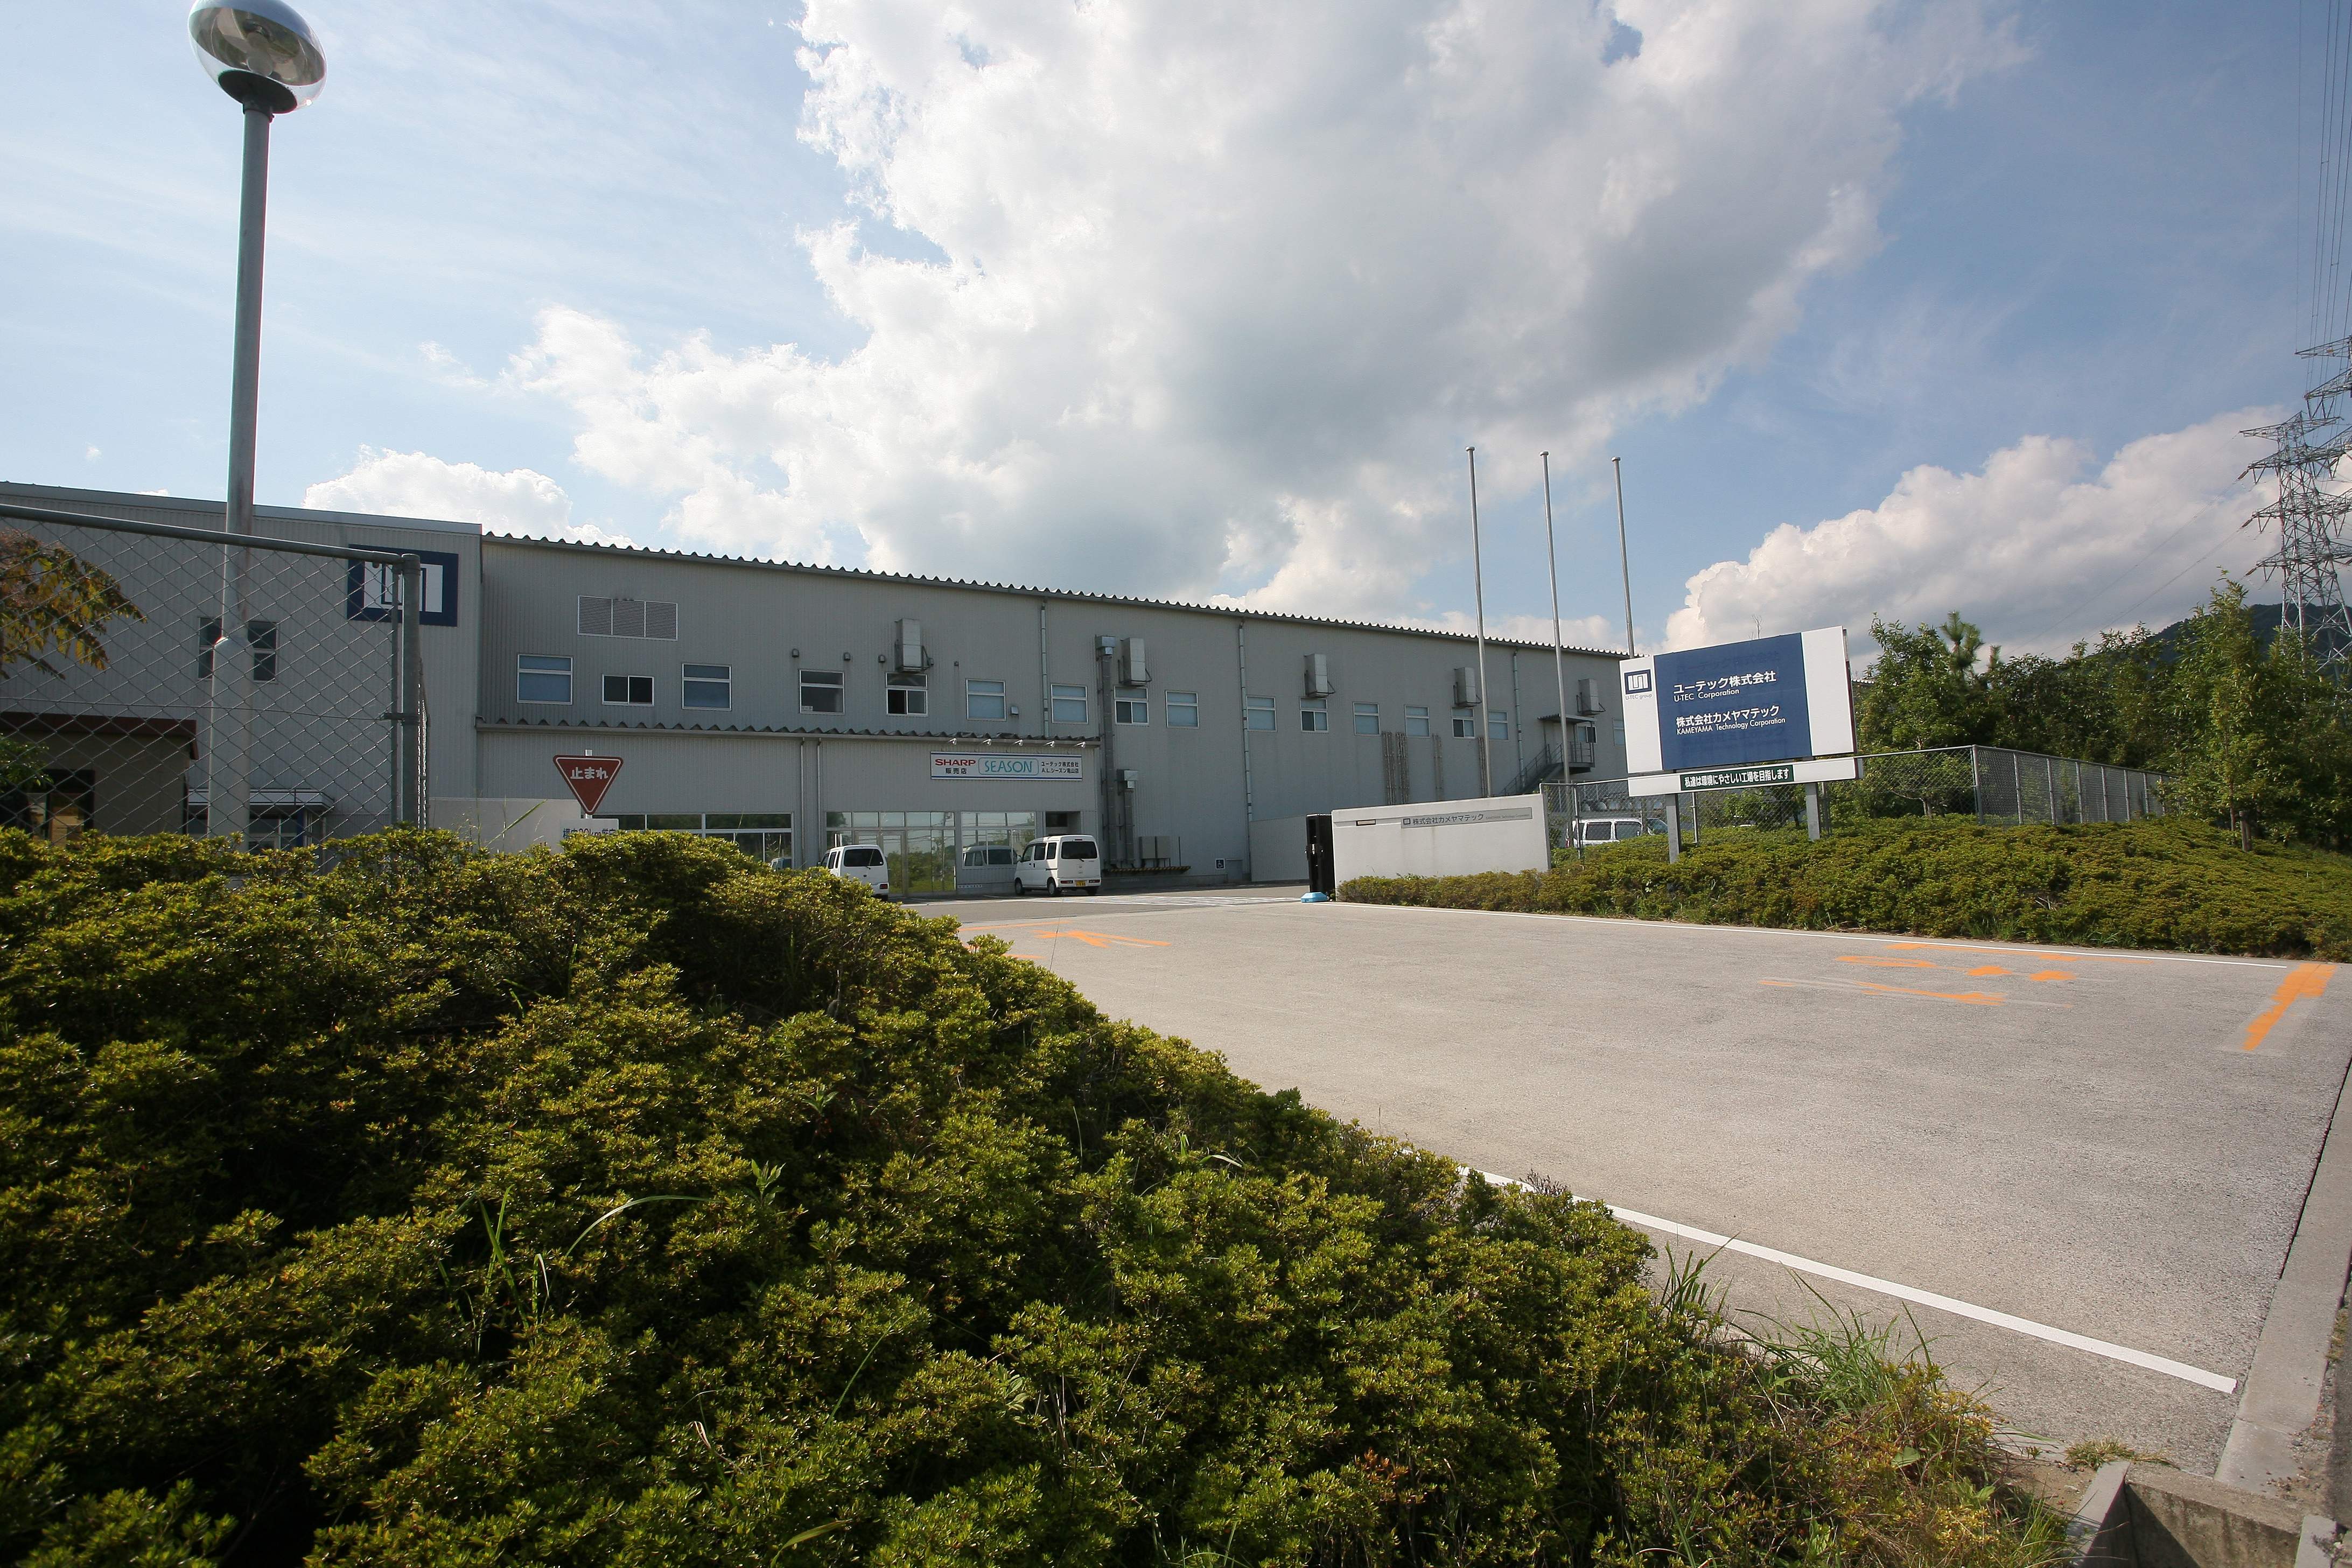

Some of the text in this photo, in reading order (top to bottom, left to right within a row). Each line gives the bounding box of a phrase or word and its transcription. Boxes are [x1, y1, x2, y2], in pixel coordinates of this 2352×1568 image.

[1674, 670, 1776, 694] ユーテック株式会社
[1698, 688, 1740, 699] Corporation
[1676, 705, 1779, 727] 株式会社カメヤマテック
[1677, 717, 1786, 735] KAMEYAMA Technology Corporation
[570, 767, 608, 780] 止まれ
[984, 760, 1033, 773] SEASON
[1684, 768, 1789, 788] 私達は環境にやさしい工場を目指します
[1413, 814, 1484, 825] 株式会社カメヤマテック
